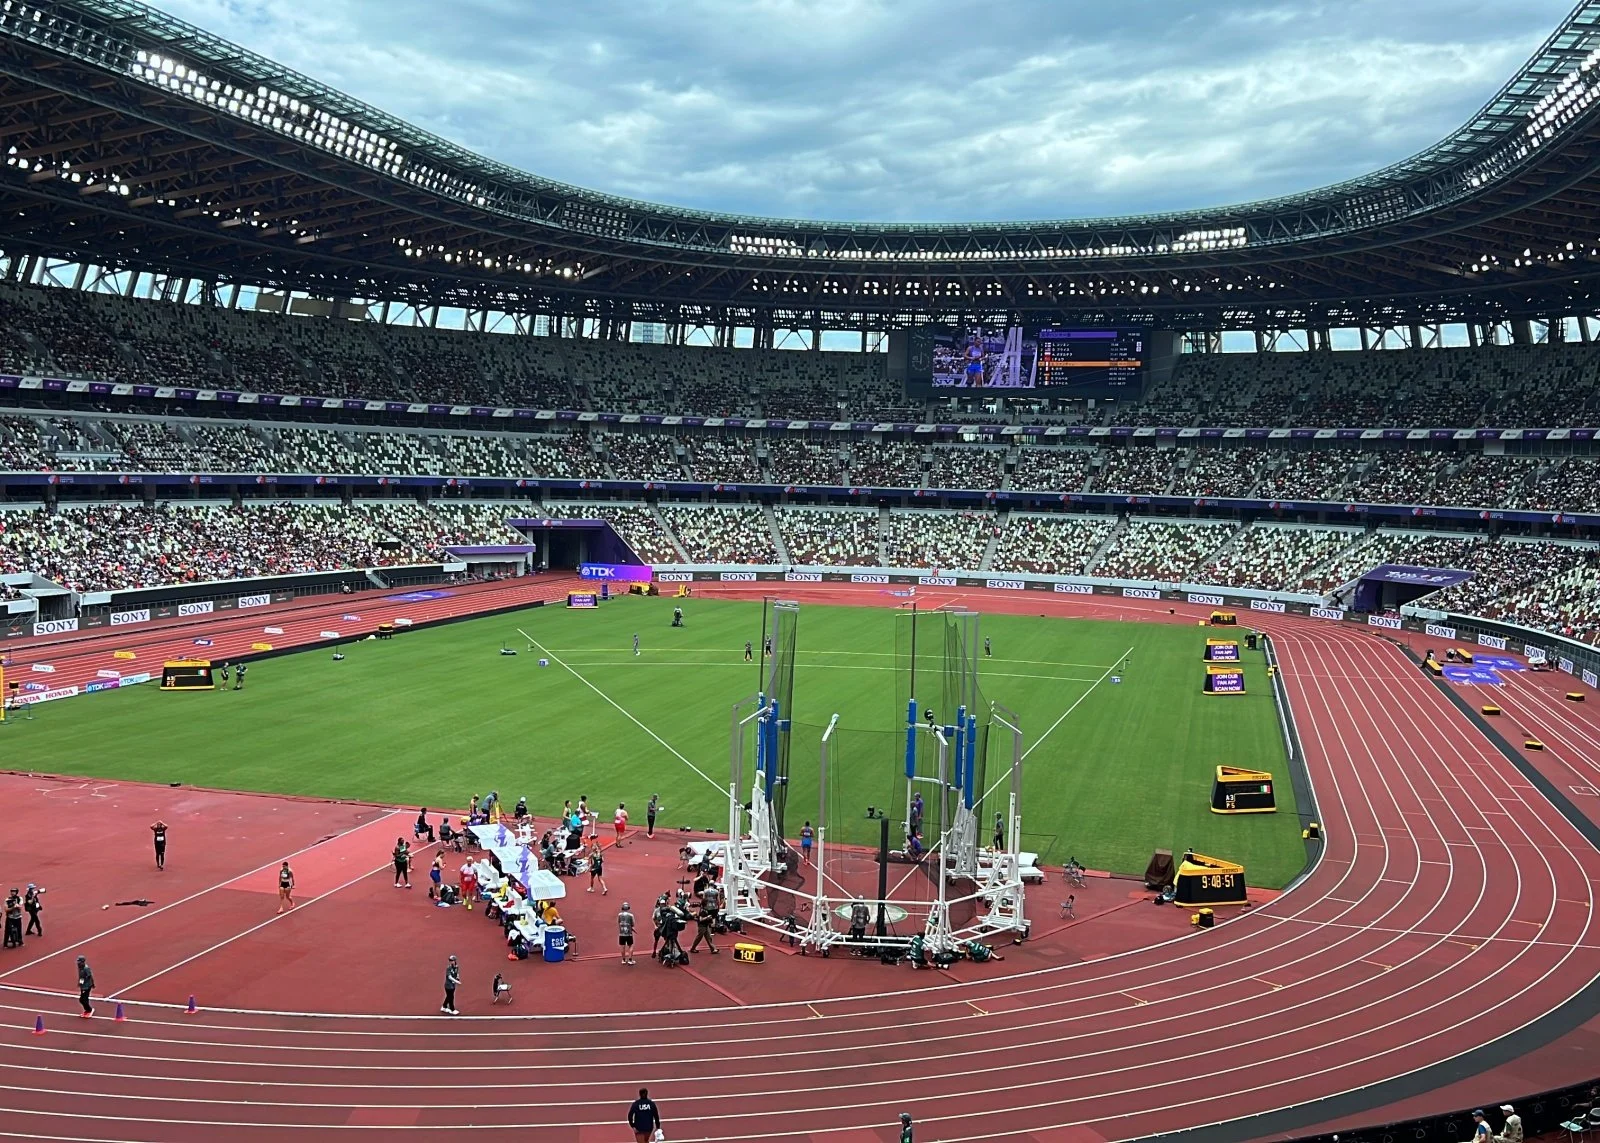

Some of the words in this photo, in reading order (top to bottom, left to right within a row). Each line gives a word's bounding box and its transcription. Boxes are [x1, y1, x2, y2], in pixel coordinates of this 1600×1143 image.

[590, 567, 614, 577] TDK
[853, 575, 887, 583] SONY
[920, 577, 955, 585] SONY
[988, 580, 1022, 589] SONY
[1056, 584, 1092, 594] SONY
[1124, 590, 1158, 598] SONY
[240, 595, 268, 607] SONY
[1189, 594, 1222, 604] SONY
[180, 602, 212, 614] SONY
[1252, 601, 1284, 612] SONY
[112, 610, 148, 624] SONY
[1312, 608, 1342, 619] SONY
[36, 620, 76, 634] SONY
[1370, 616, 1400, 628] SONY
[1427, 626, 1455, 638] SONY
[1480, 636, 1505, 649] SONY
[1526, 646, 1544, 658] SONY
[1584, 672, 1596, 686] SONY
[45, 689, 74, 699] HONDA
[1202, 874, 1234, 888] 9:48:51
